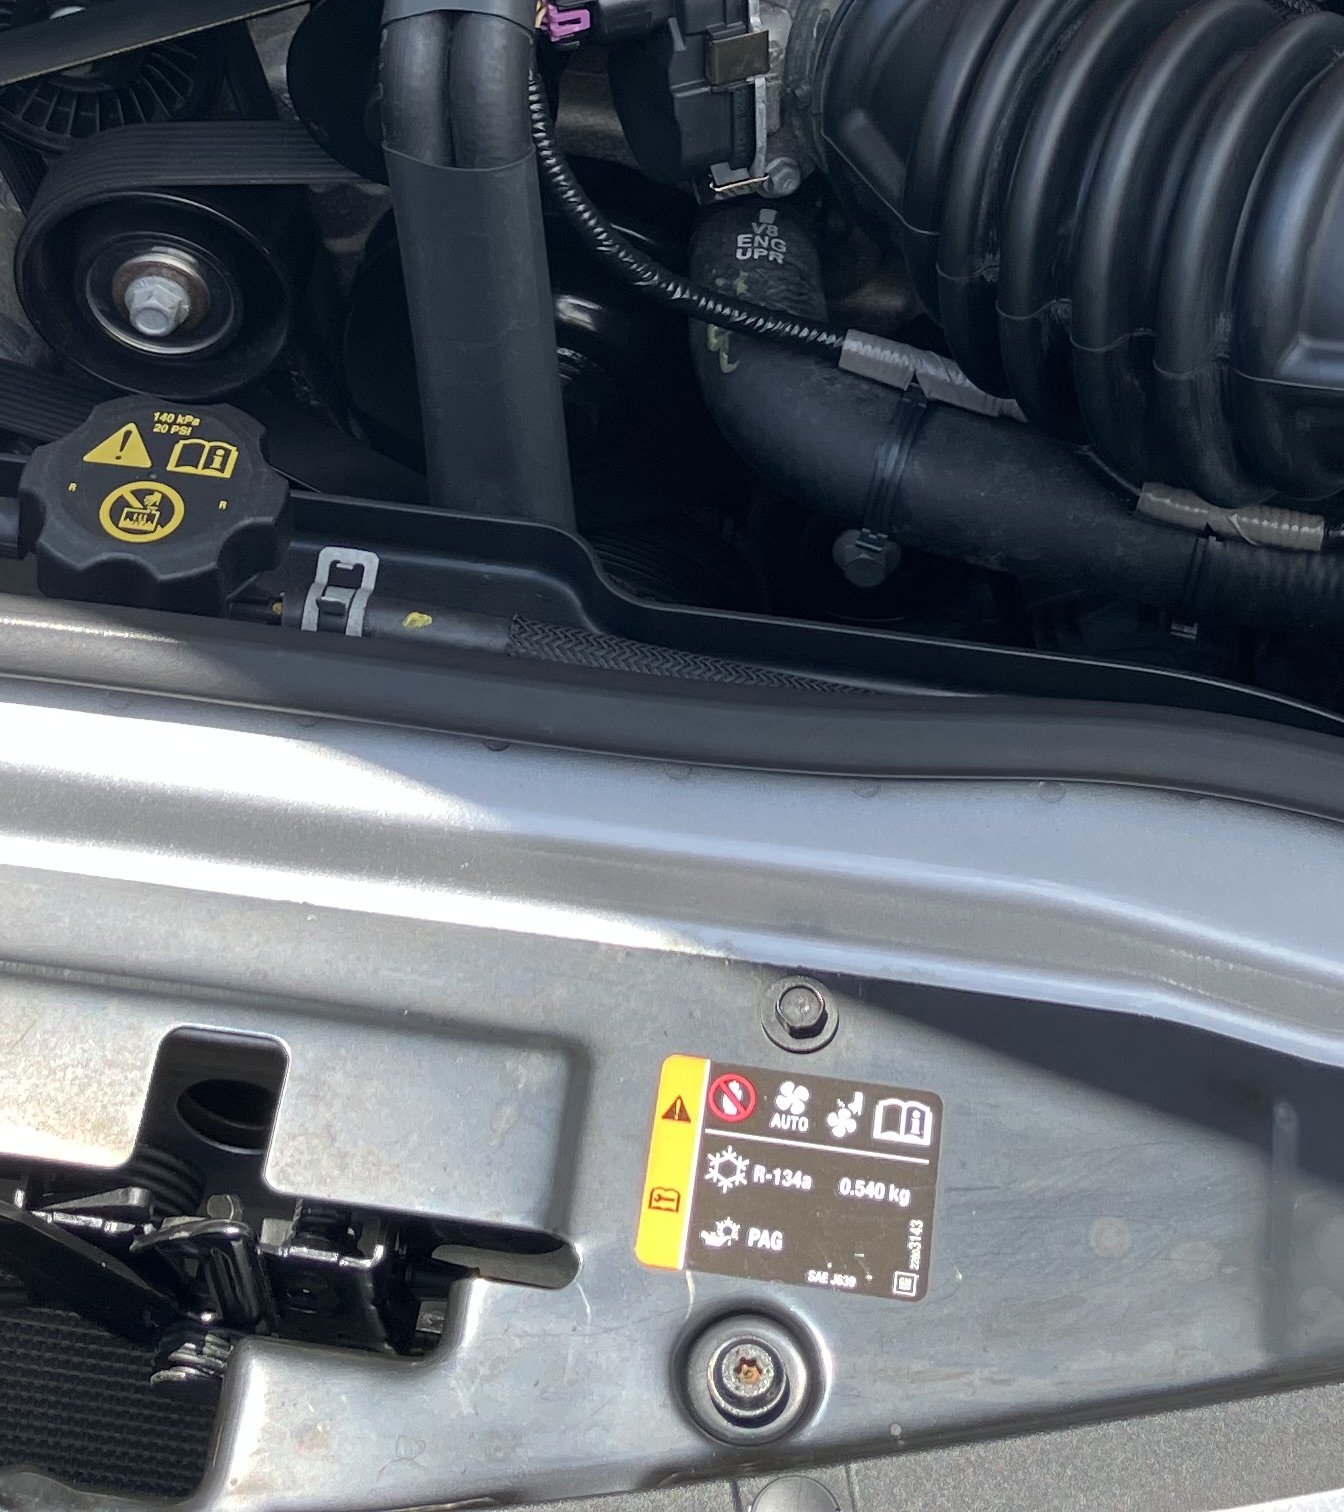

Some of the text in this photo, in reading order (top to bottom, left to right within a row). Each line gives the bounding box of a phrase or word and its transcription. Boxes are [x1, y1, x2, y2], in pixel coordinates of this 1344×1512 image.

[751, 222, 779, 238] V8
[737, 234, 787, 253] ENG
[736, 248, 784, 264] UPR
[153, 411, 175, 424] 140
[153, 423, 192, 436] 20 PSI
[770, 1113, 809, 1132] AUTO
[753, 1164, 911, 1207] R-134a 0.540 kg
[747, 1227, 783, 1251] PAG
[807, 1270, 829, 1285] SAE
